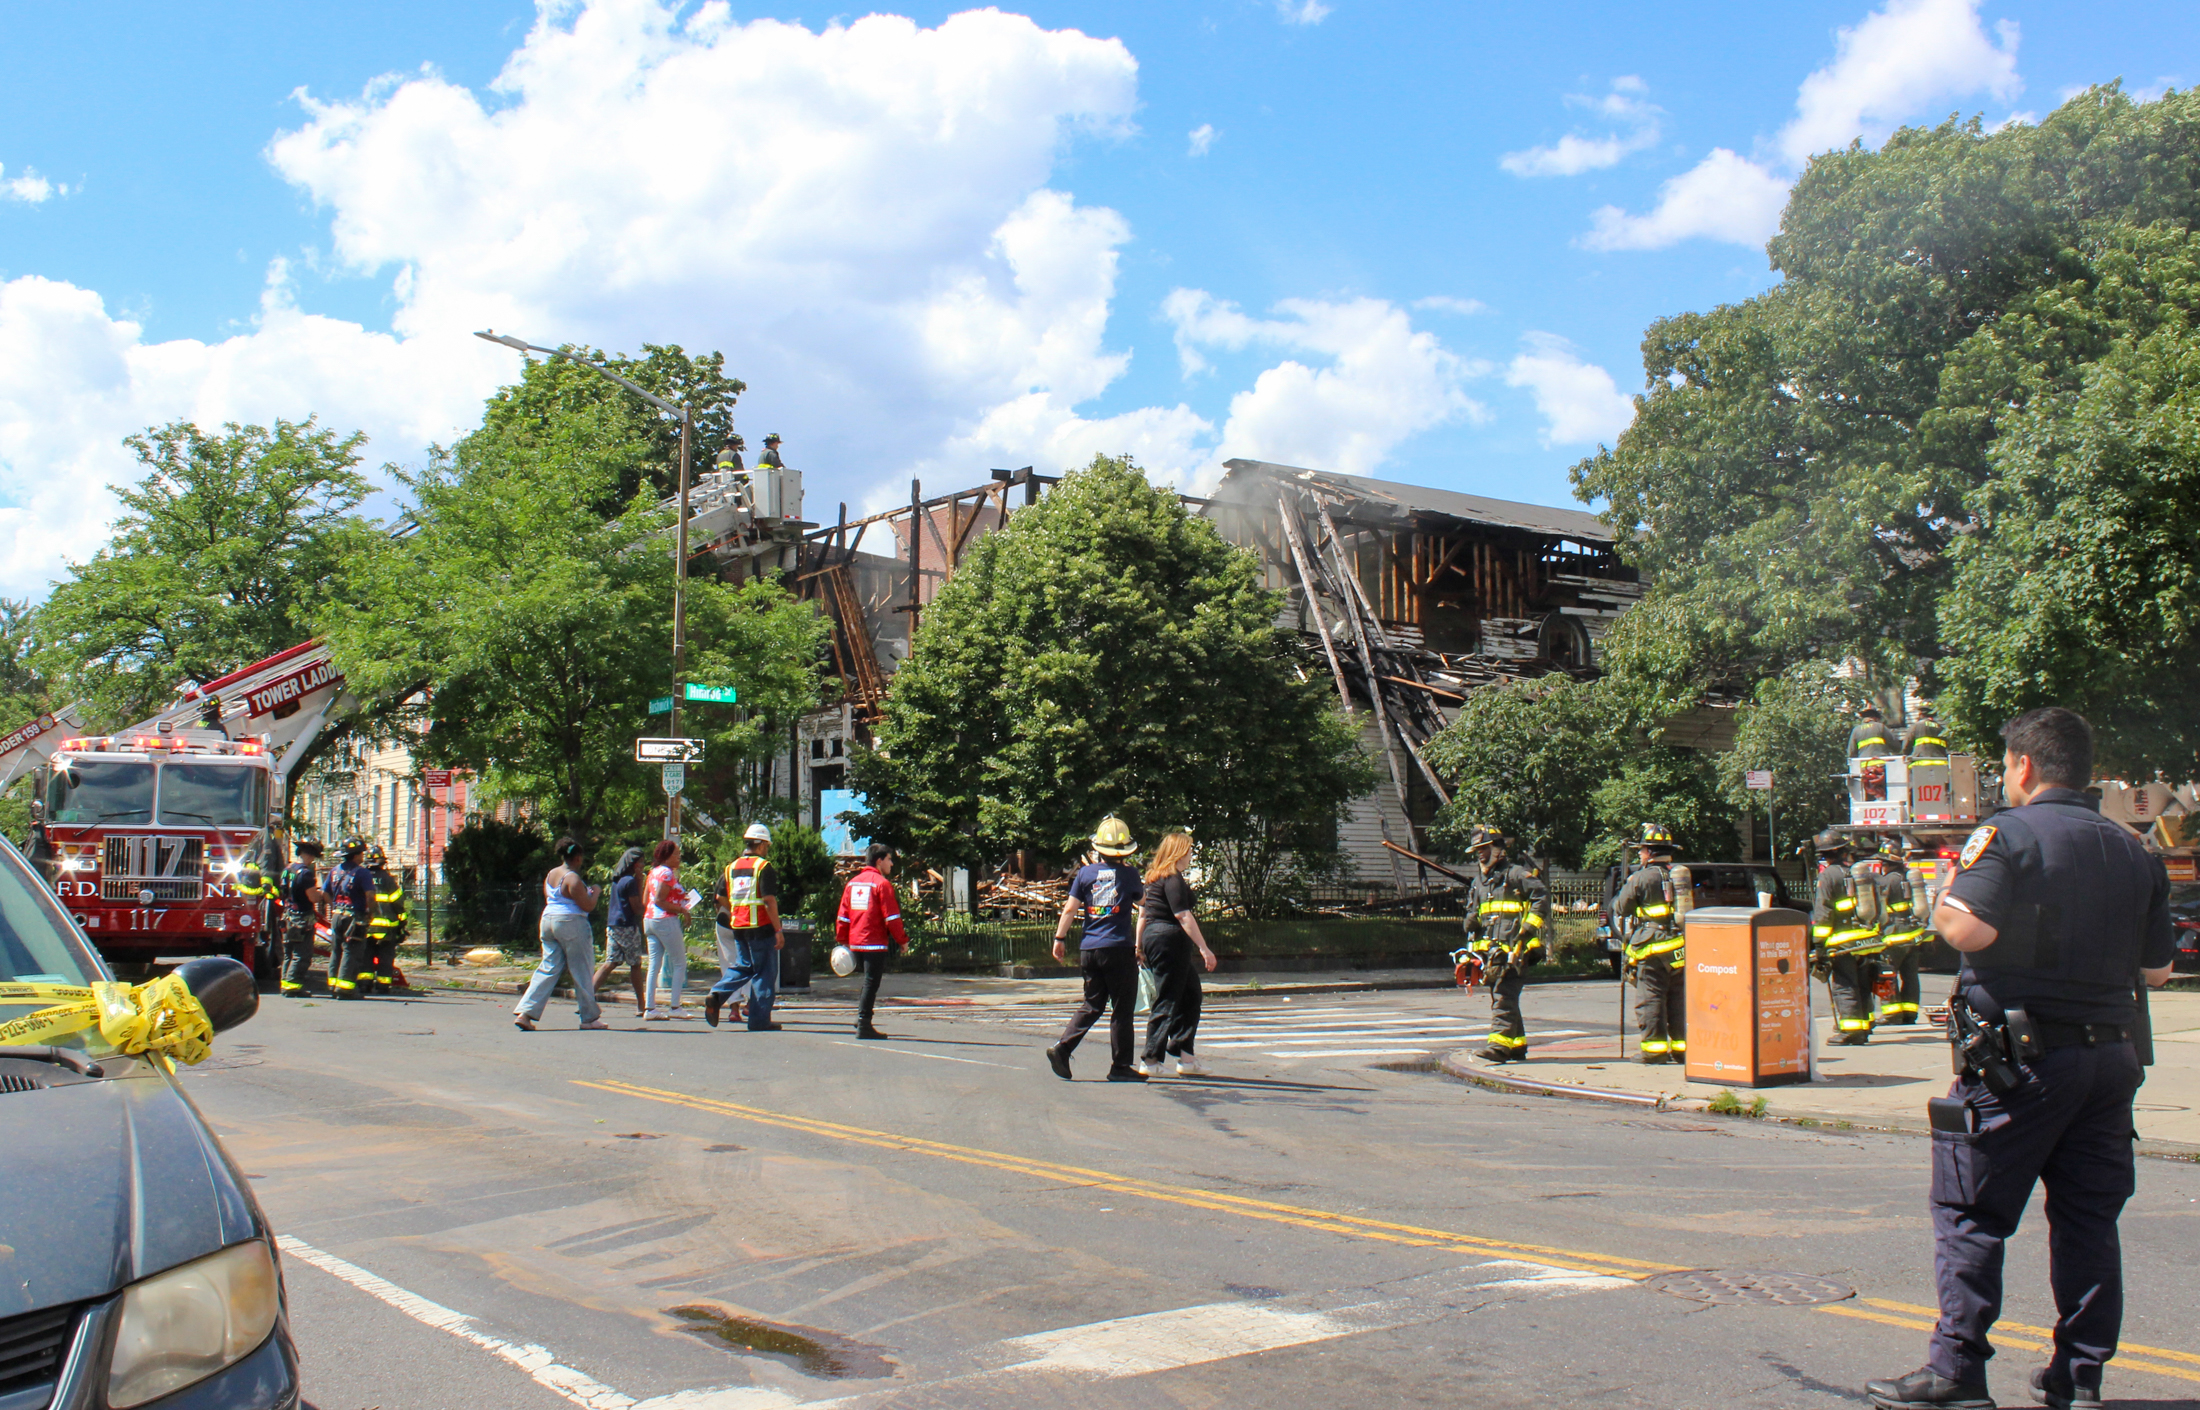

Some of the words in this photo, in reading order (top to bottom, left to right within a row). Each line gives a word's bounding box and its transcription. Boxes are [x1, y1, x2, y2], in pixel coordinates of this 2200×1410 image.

[252, 678, 301, 712] TOWER
[23, 724, 40, 739] 159
[1918, 785, 1942, 802] 107
[1864, 808, 1887, 819] 107
[127, 835, 186, 878] 117
[57, 882, 99, 897] F.D.
[130, 909, 168, 930] 117
[1760, 941, 1775, 949] What
[1775, 941, 1790, 950] goes
[1760, 950, 1766, 958] in
[1766, 949, 1778, 958] this
[1778, 949, 1792, 958] Bin?
[1697, 963, 1738, 976] Compost
